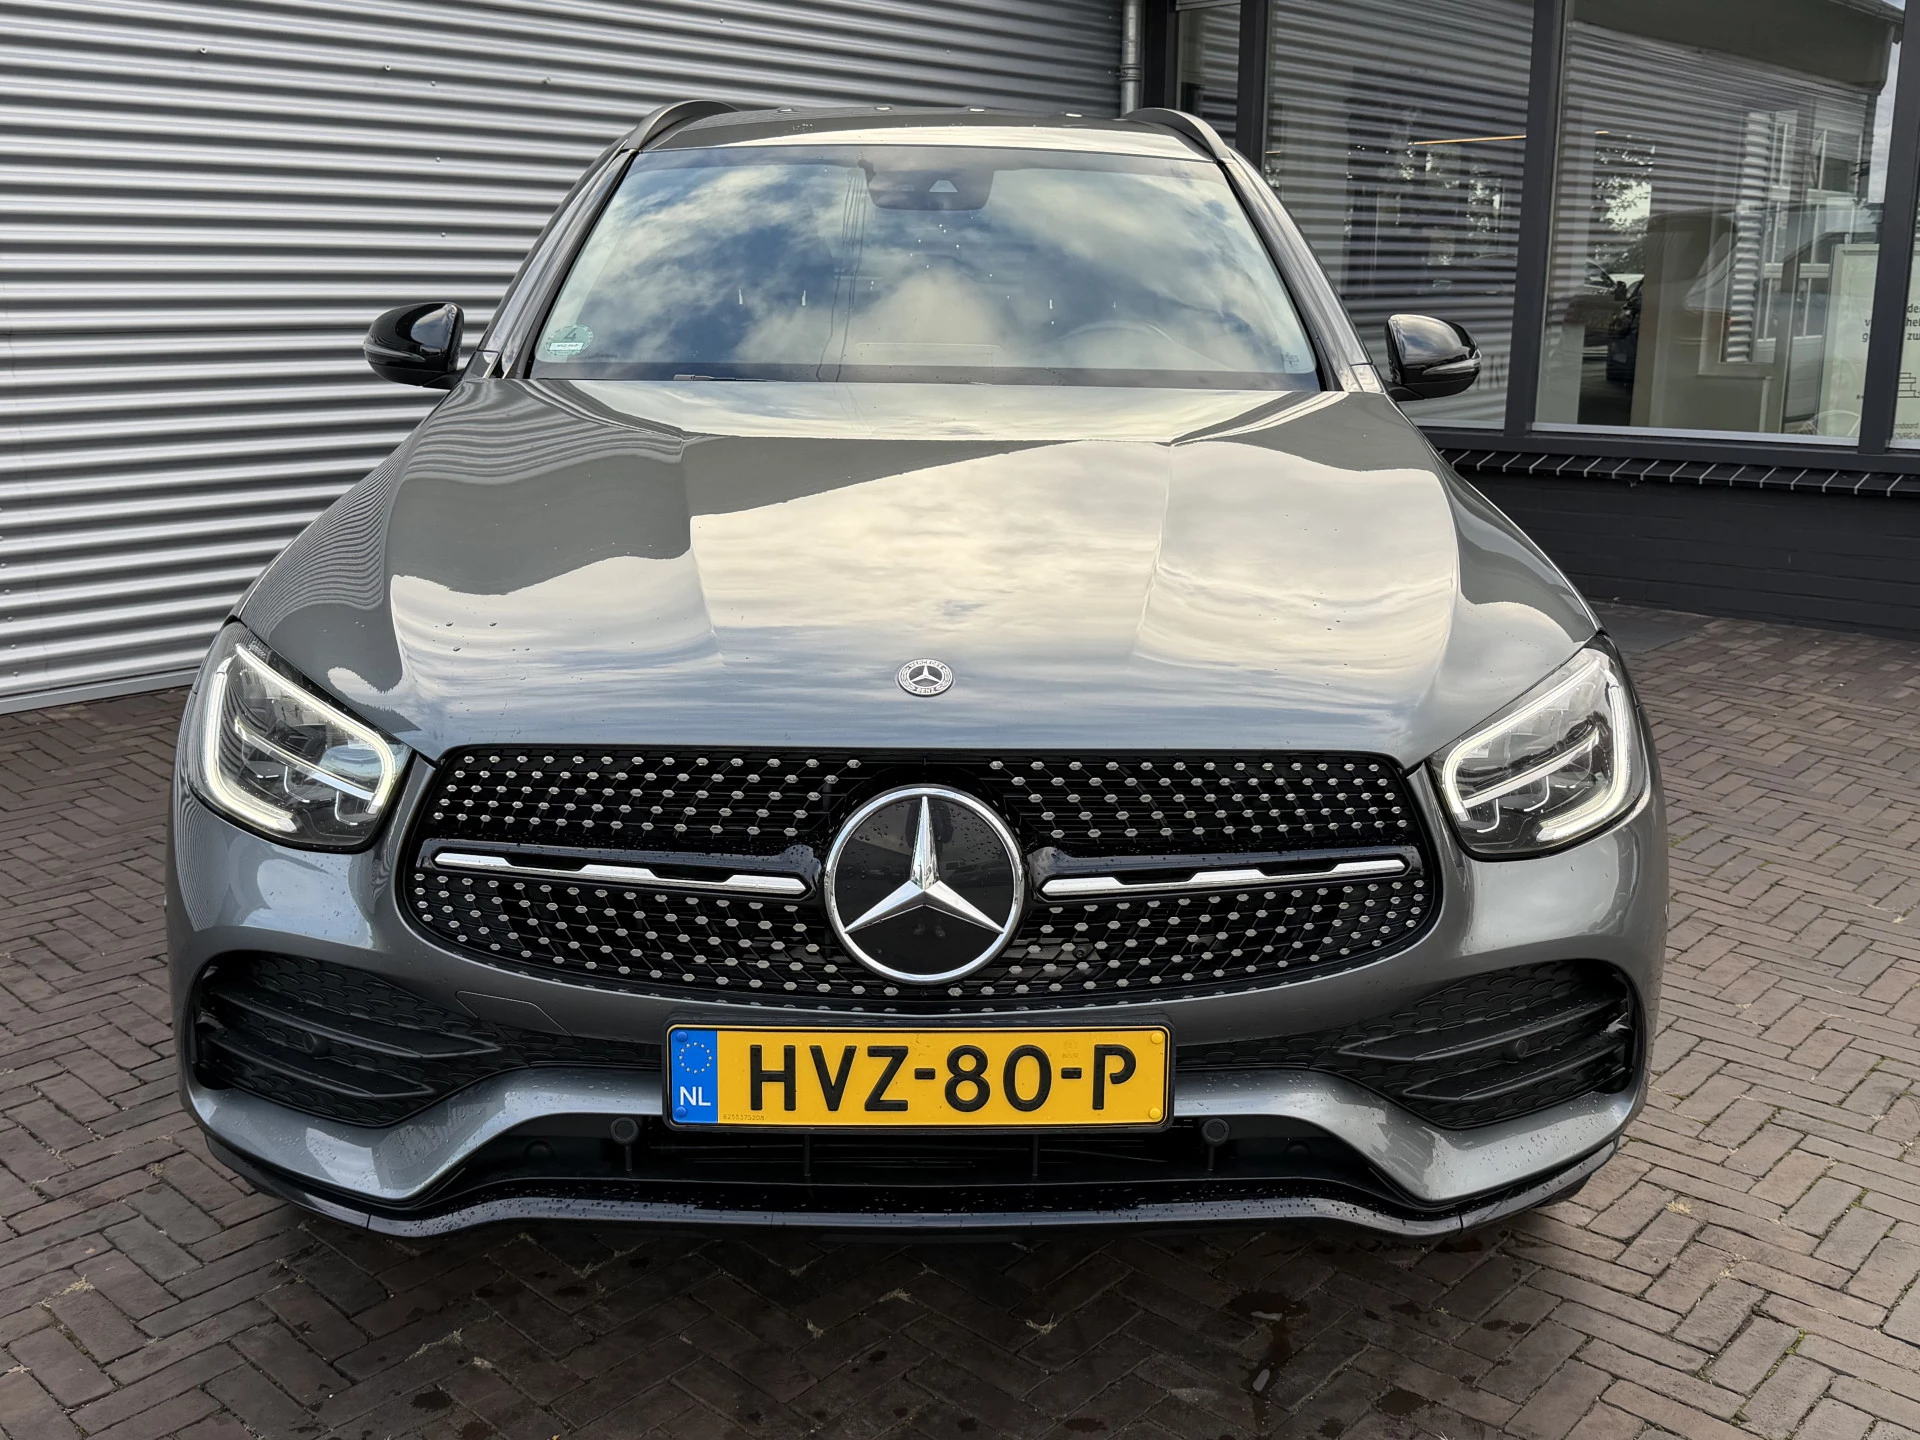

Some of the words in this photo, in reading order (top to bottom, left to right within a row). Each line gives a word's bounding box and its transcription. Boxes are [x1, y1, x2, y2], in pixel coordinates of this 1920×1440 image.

[563, 327, 578, 341] 4
[750, 1044, 1137, 1112] HVZ-80-P
[679, 1086, 711, 1107] NL
